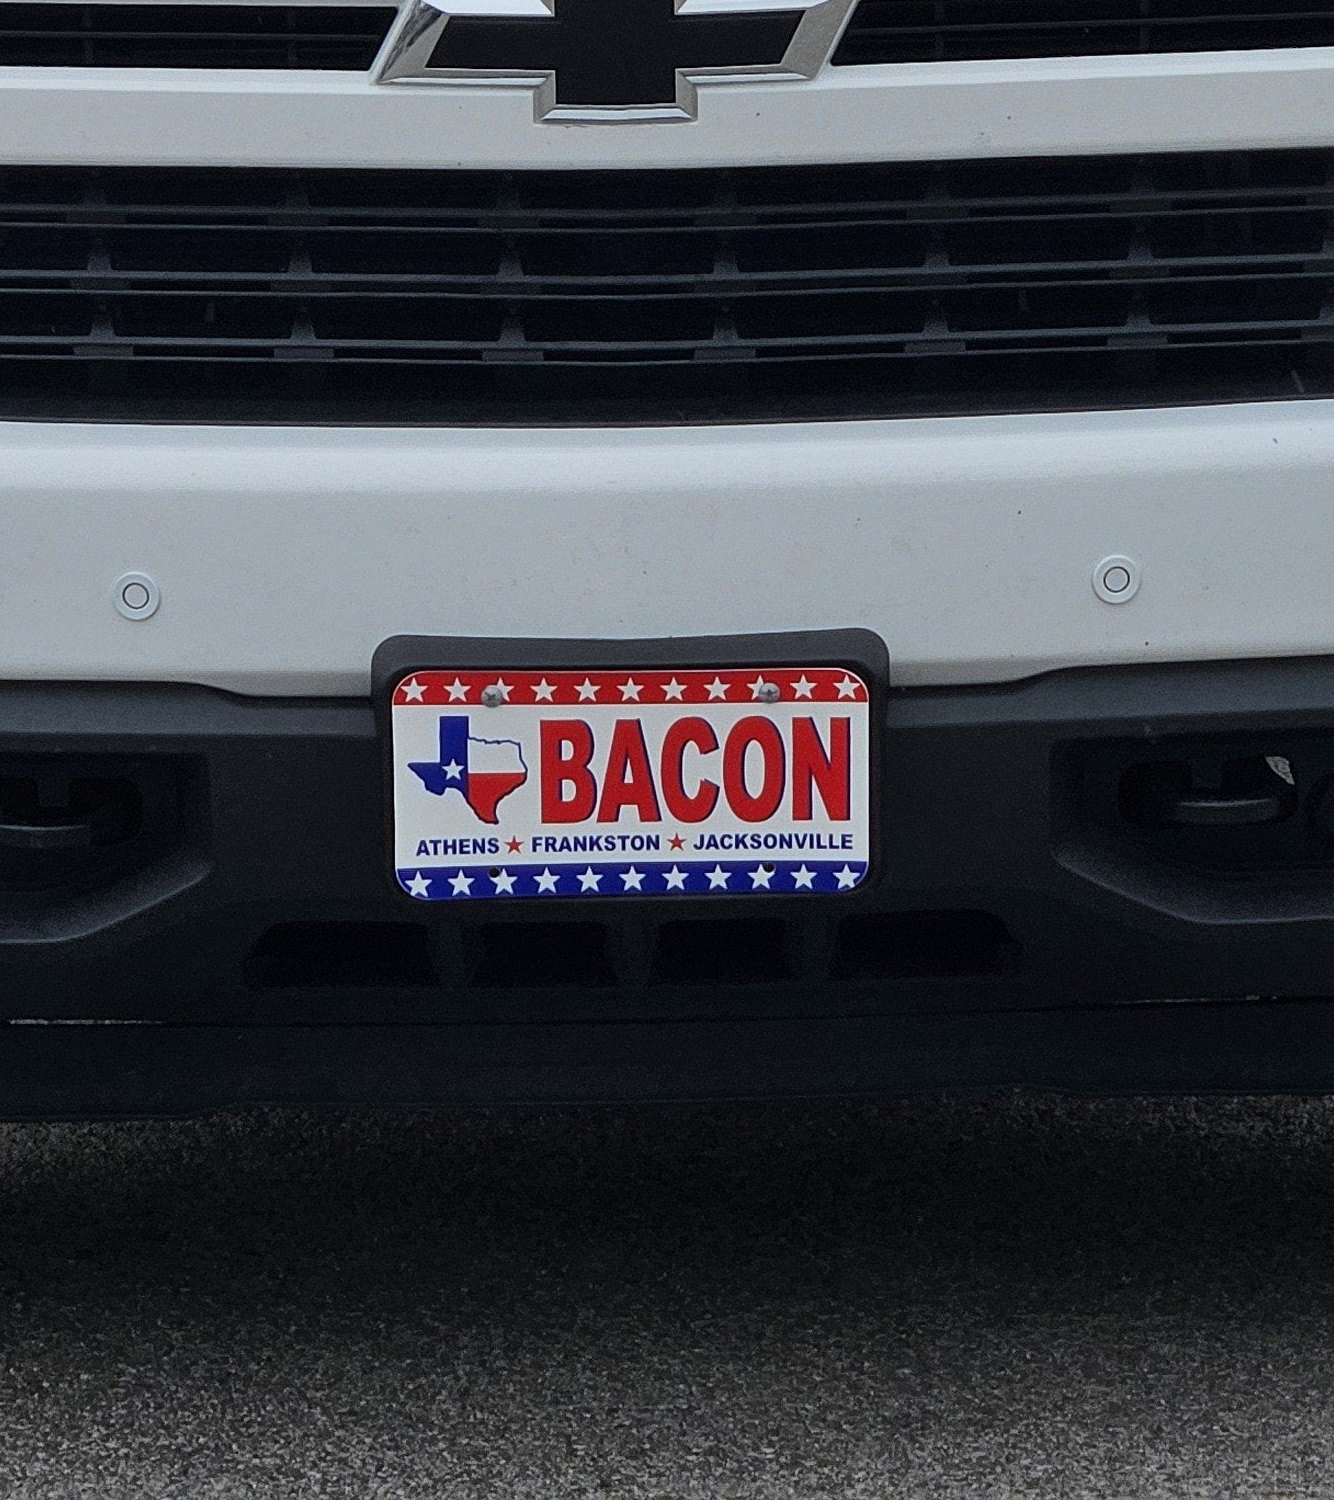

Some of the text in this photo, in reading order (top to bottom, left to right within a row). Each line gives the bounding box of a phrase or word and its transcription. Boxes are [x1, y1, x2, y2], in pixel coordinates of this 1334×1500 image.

[539, 715, 851, 825] BACON
[415, 833, 854, 857] ATHENS FRANKSTON JACKSONVILLE
